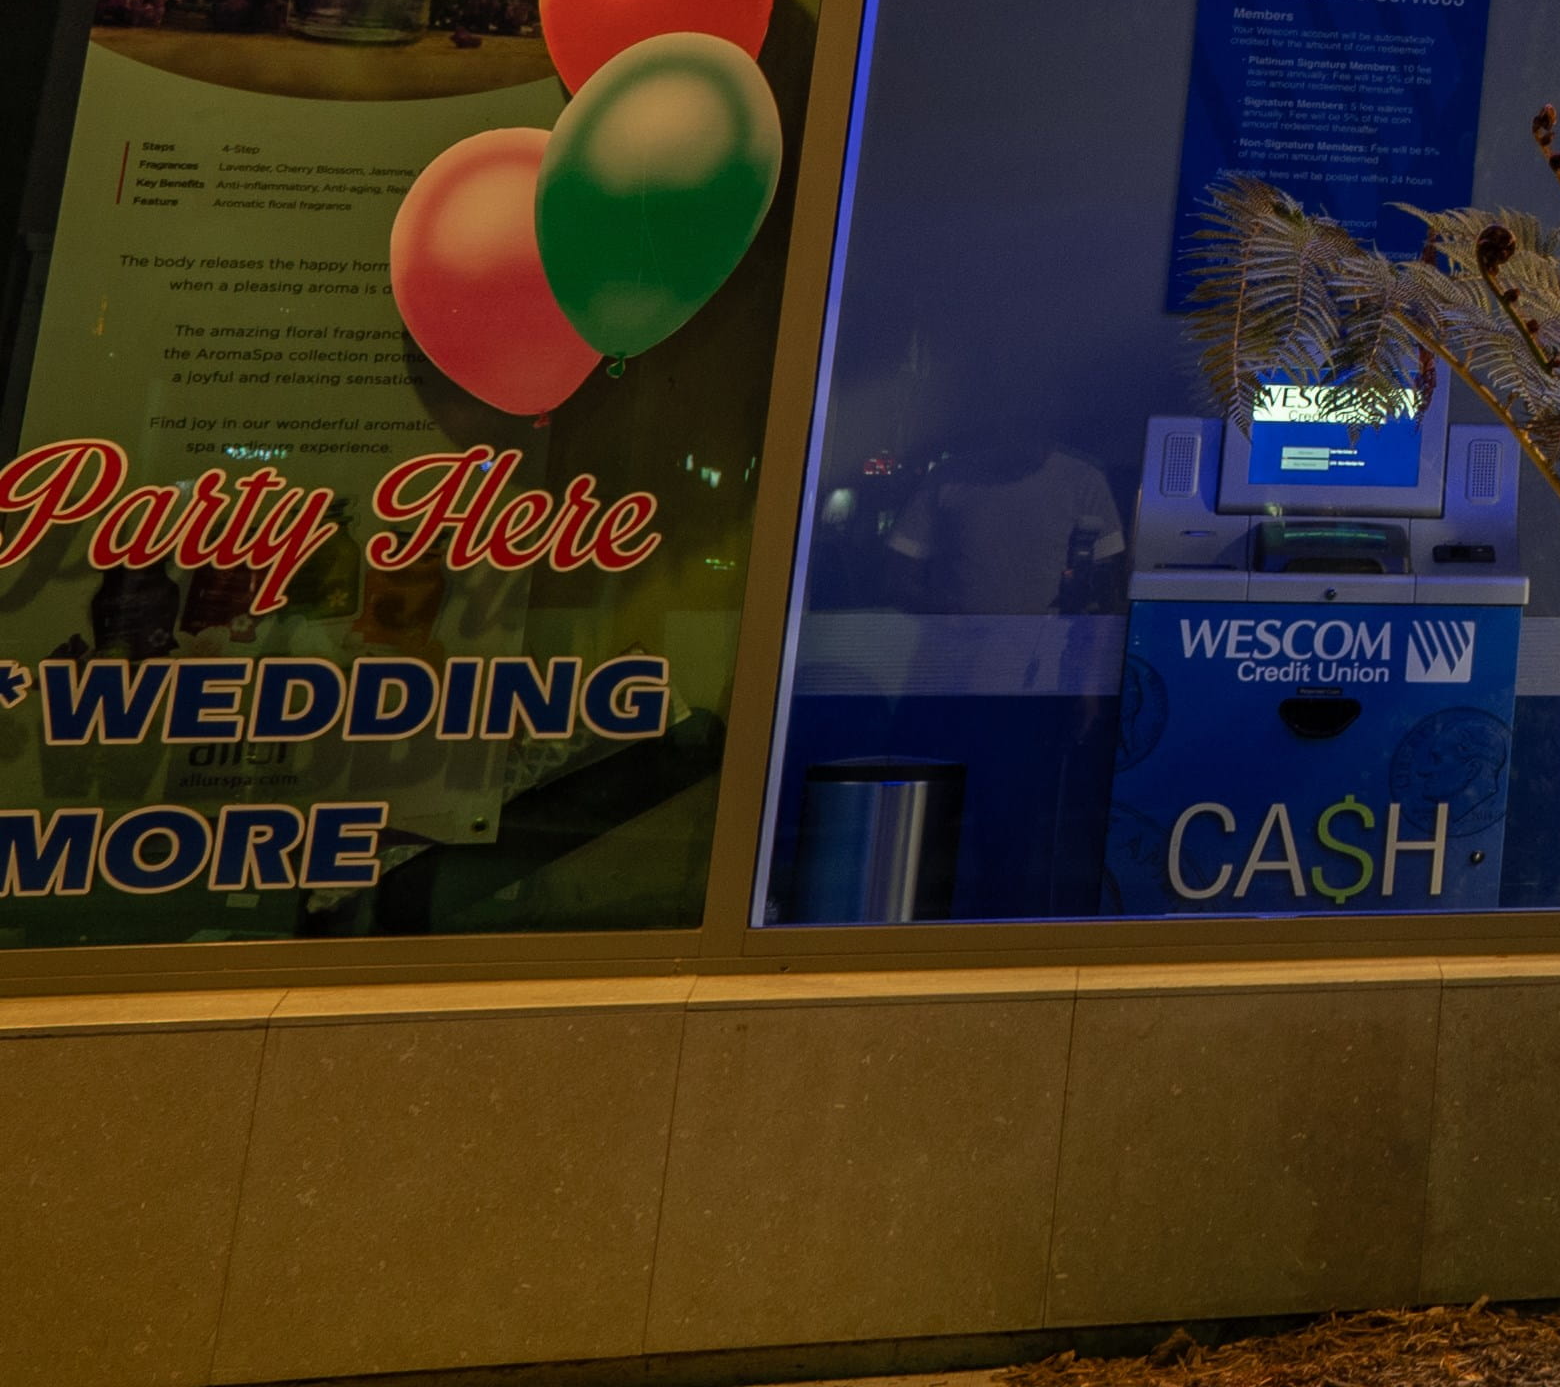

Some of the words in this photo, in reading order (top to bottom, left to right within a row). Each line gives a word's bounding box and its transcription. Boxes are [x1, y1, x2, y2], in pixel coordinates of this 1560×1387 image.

[1233, 7, 1294, 22] Members
[1247, 55, 1294, 67] Platinum
[142, 141, 176, 153] Steps
[221, 144, 260, 156] 4-Step
[1239, 138, 1315, 150] Non-Signature
[139, 159, 199, 172] Fragrances
[219, 162, 272, 173] Lavender,
[275, 163, 313, 175] Cherry
[316, 165, 364, 176] Blossom,
[368, 166, 416, 178] Jasmine,
[136, 178, 158, 190] Key
[160, 178, 205, 189] Benefits
[216, 180, 321, 194] Anti-inflammatory,
[324, 182, 384, 196] Anti-aging,
[133, 196, 179, 207] Feature
[213, 198, 265, 209] Aromatic
[268, 200, 297, 210] floral
[299, 200, 352, 213] fragrance
[121, 255, 149, 268] The
[153, 256, 197, 271] body
[200, 257, 265, 270] releases
[269, 259, 294, 271] the
[299, 259, 346, 275] happy
[169, 280, 214, 292] when
[220, 283, 229, 292] a
[233, 282, 303, 296] pleasing
[307, 284, 359, 294] aroma
[364, 283, 377, 295] is
[175, 325, 206, 338] The
[209, 328, 280, 342] amazing
[286, 326, 328, 340] floral
[163, 348, 191, 361] the
[195, 349, 284, 364] AromaSpa
[288, 350, 368, 363] collection
[171, 373, 182, 383] a
[186, 371, 235, 386] joyful
[239, 372, 271, 384] and
[275, 373, 341, 387] relaxing
[150, 417, 187, 429] Find
[190, 417, 218, 432] joy
[223, 418, 238, 429] in
[242, 420, 272, 430] our
[275, 418, 360, 431] wonderful
[363, 419, 436, 432] aromatic
[185, 442, 216, 454] spa
[300, 442, 393, 456] experience.
[0, 438, 338, 615] Party
[367, 445, 662, 572] Here
[1179, 618, 1392, 660] WESCOM
[1236, 660, 1311, 683] Credit
[1317, 661, 1390, 683] Union
[0, 802, 389, 896] MORE
[1166, 794, 1449, 904] CA$H
